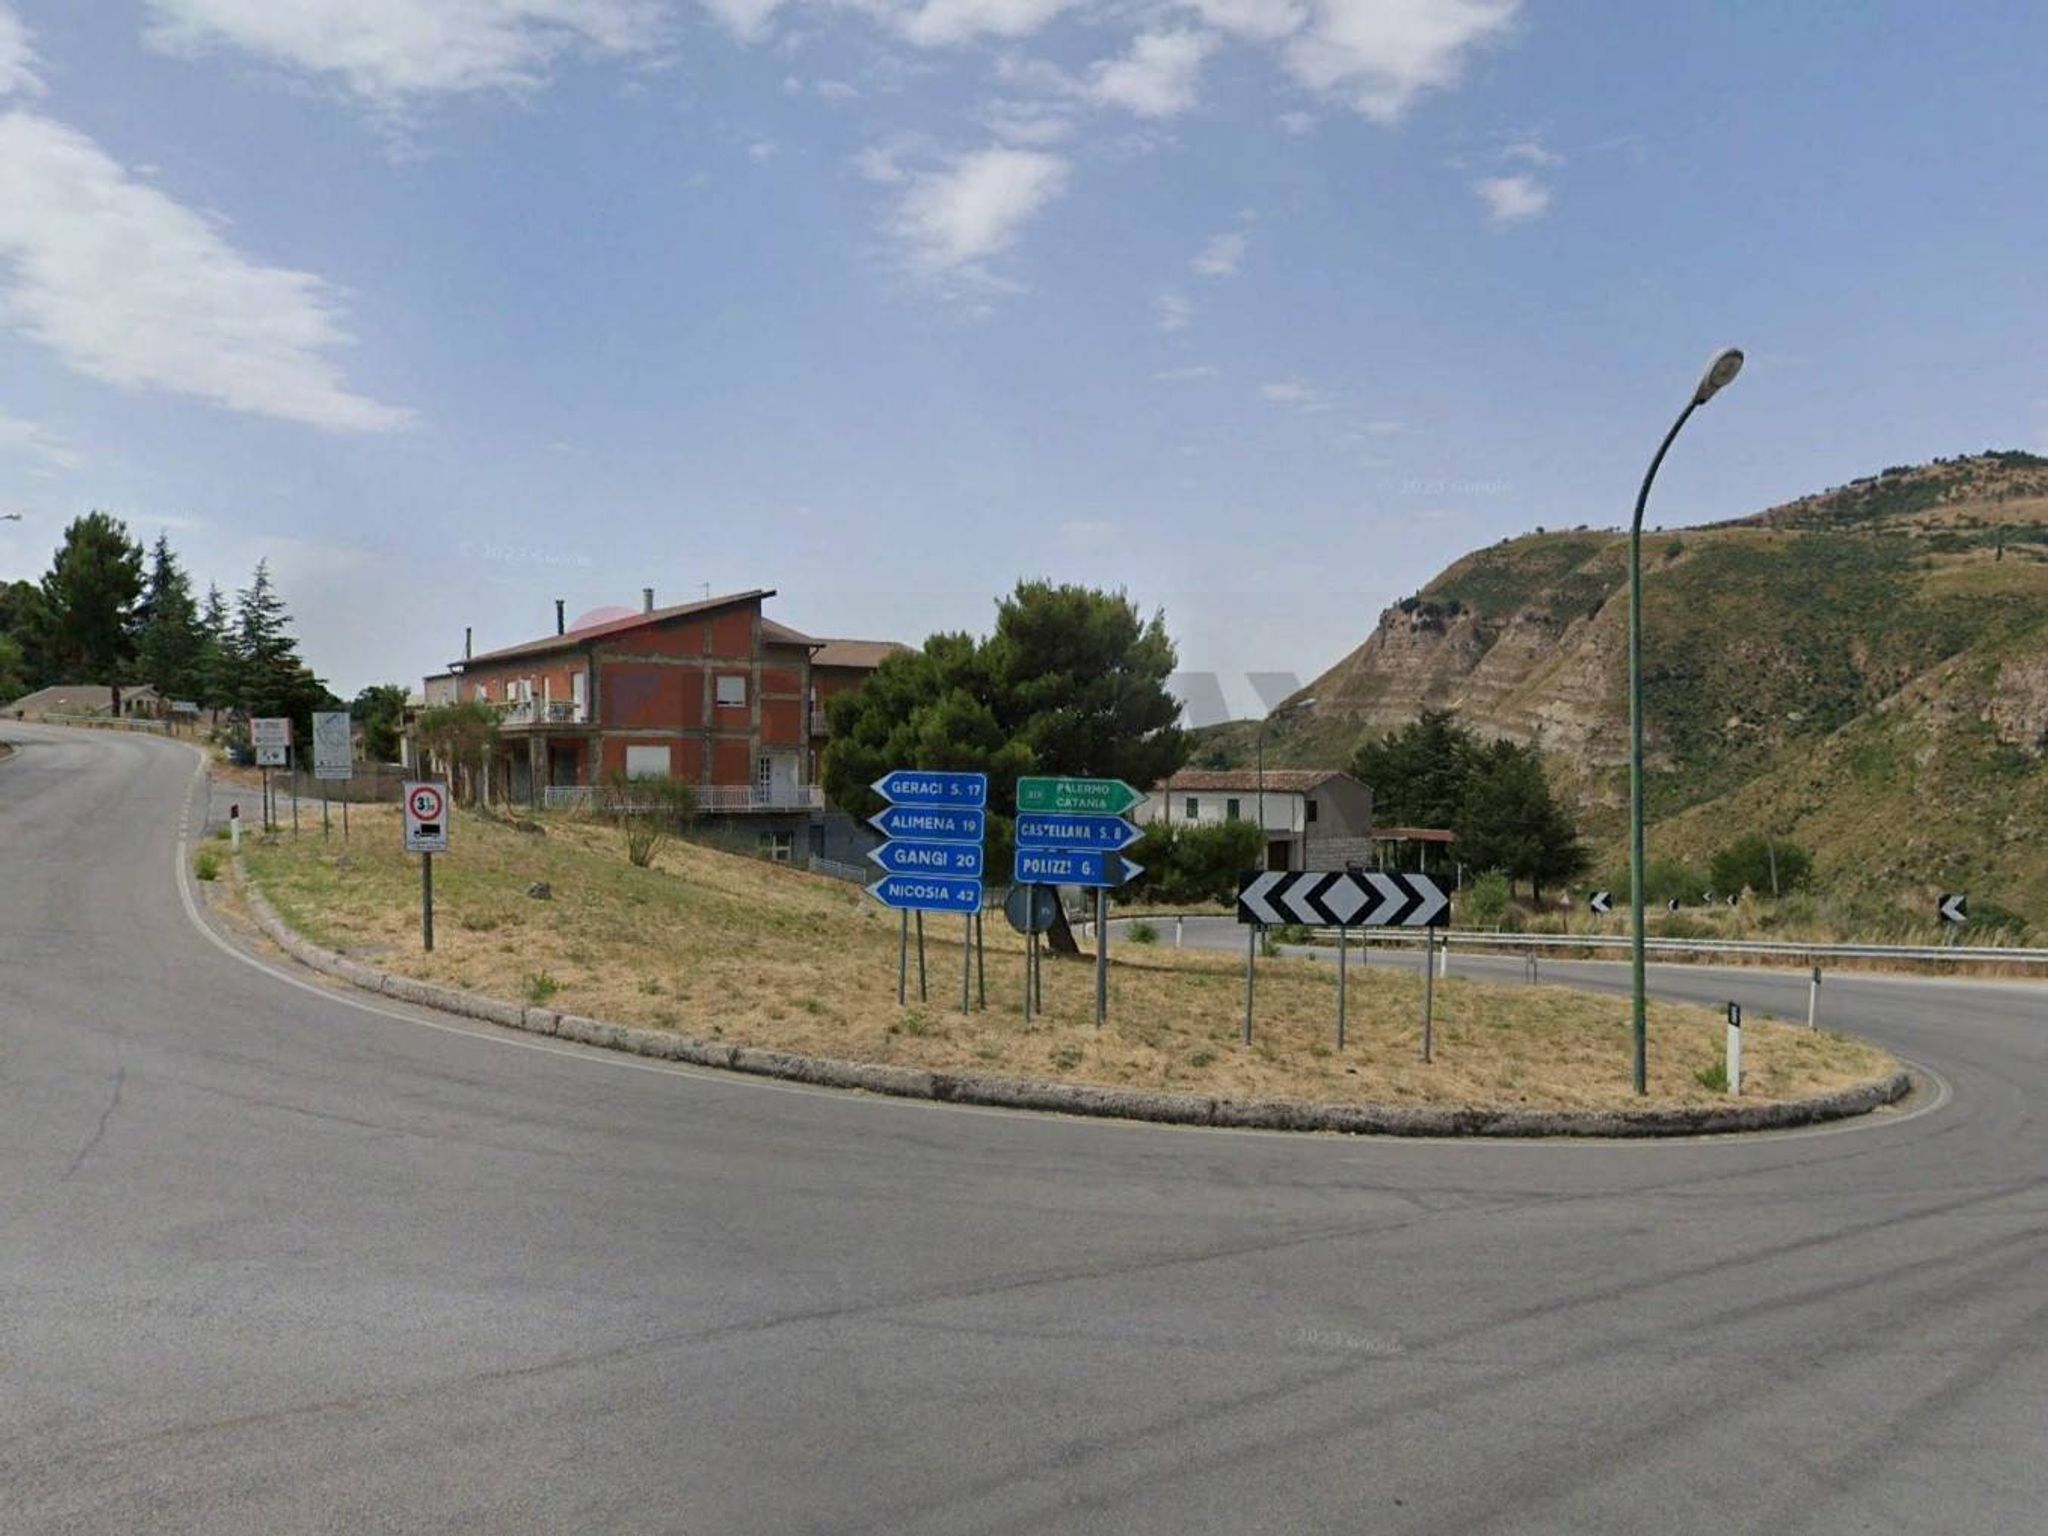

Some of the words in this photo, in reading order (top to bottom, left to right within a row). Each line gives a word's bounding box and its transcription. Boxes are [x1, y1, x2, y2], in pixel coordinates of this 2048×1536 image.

[892, 781, 943, 795] GERACI
[950, 783, 963, 796] S.
[967, 785, 981, 796] 17
[1056, 783, 1110, 795] PALERMO
[1056, 797, 1107, 809] CATANIA
[891, 815, 955, 831] ALIMENA
[963, 820, 977, 832] 19
[895, 849, 948, 866] GANGI
[956, 854, 976, 868] 20
[1023, 859, 1072, 875] POLIZZI
[1082, 861, 1096, 876] G.
[888, 883, 950, 900] NICOSIA
[956, 889, 975, 901] 42
